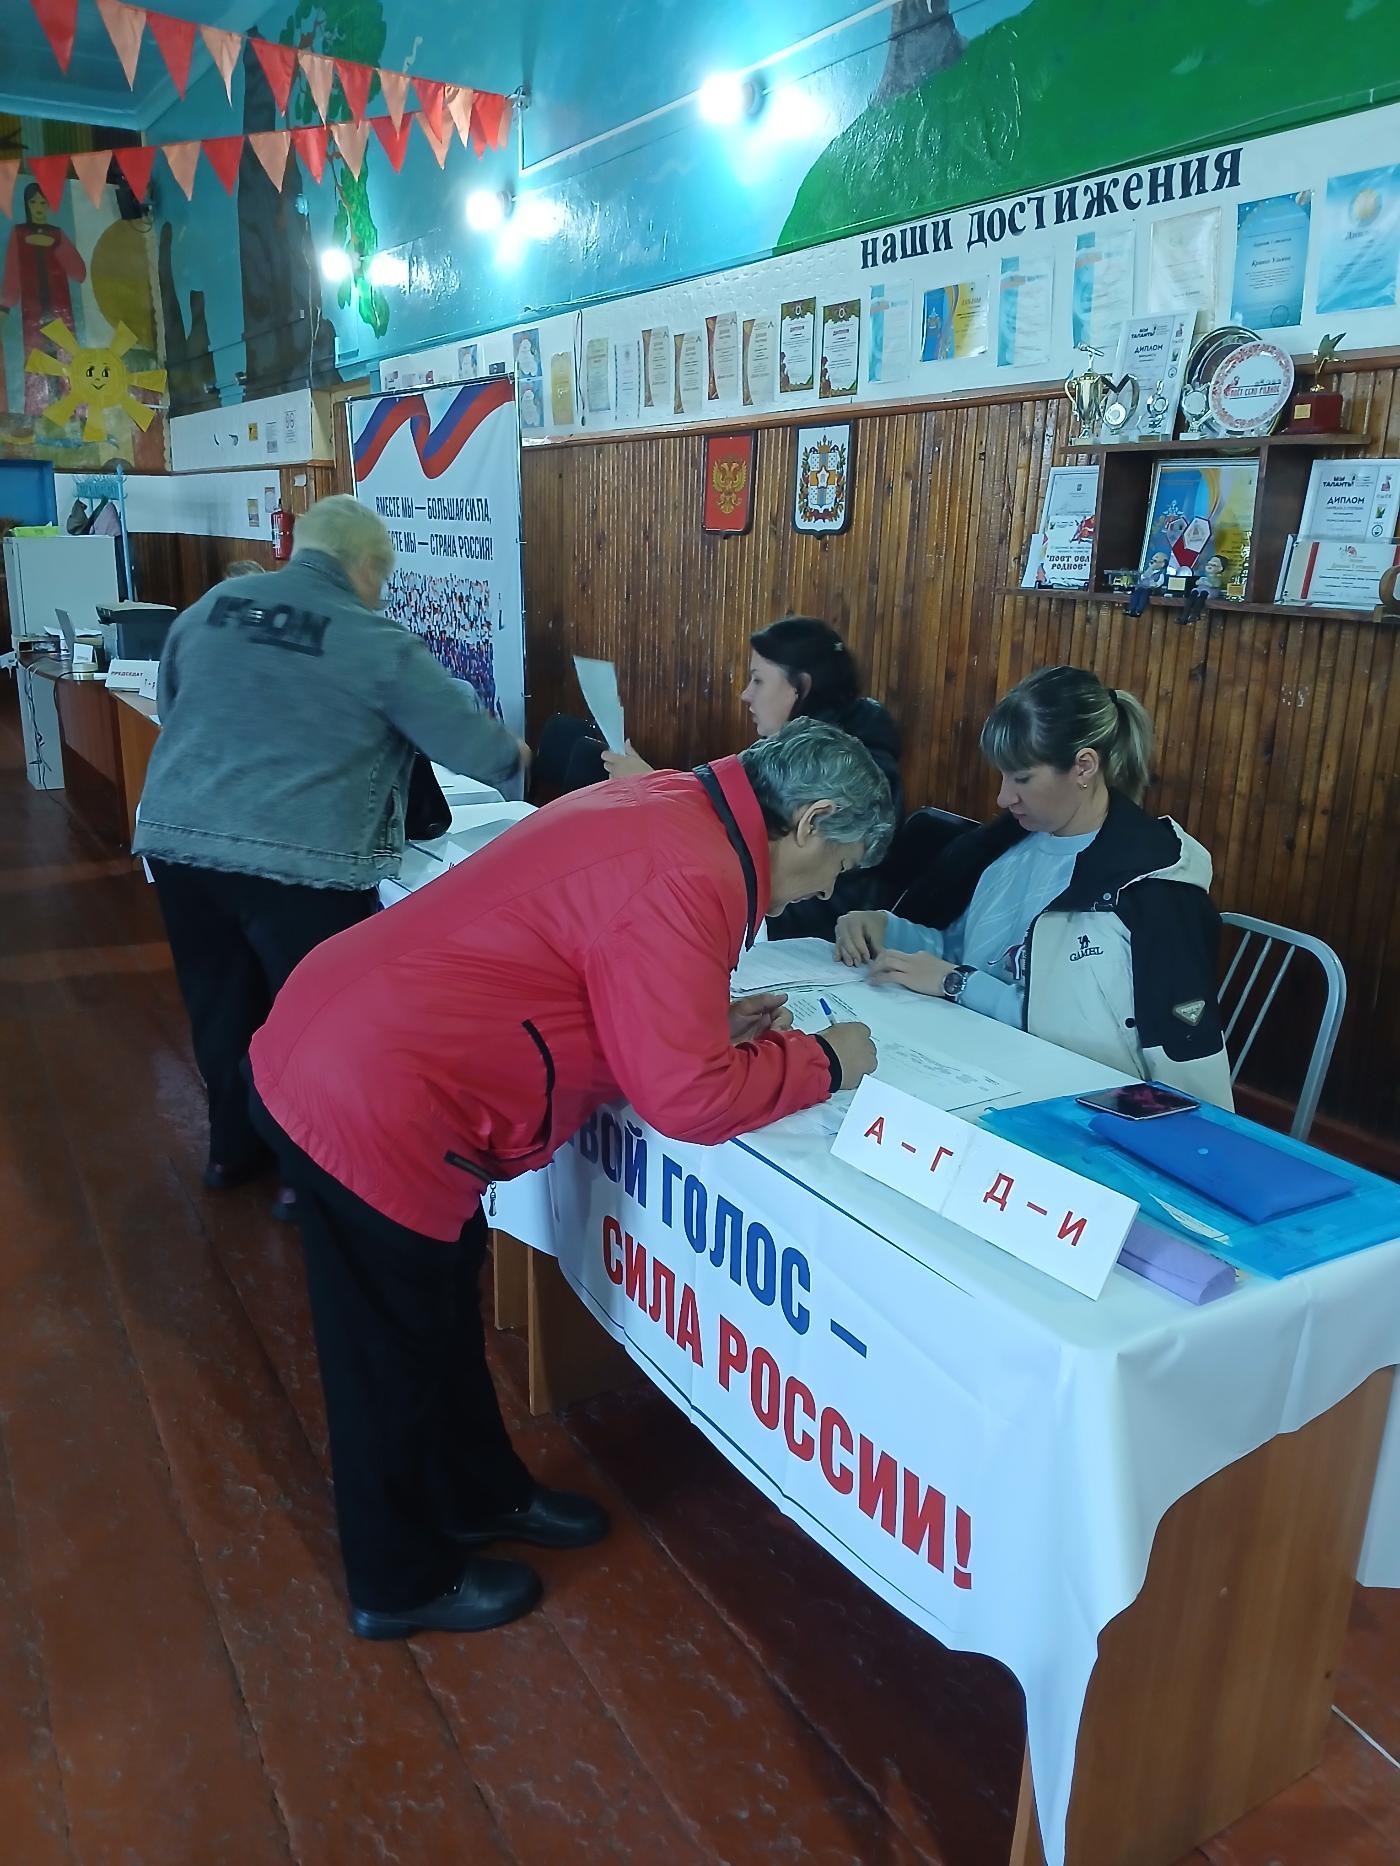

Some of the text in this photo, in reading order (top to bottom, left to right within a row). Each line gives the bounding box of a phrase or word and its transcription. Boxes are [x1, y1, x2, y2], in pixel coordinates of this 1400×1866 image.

[860, 147, 1243, 269] наши достижения
[1134, 344, 1163, 354] ДИПЛОМ
[375, 496, 401, 518] ВМЕСТЕ
[401, 497, 414, 519] МЫ
[427, 497, 464, 521] БОЛЬШАЯ
[464, 497, 492, 525] СИЛА,
[1327, 496, 1366, 505] ДИПЛОМ
[403, 531, 417, 554] МЫ
[429, 533, 458, 558] СТРАНА
[457, 535, 493, 561] РОССИЯ!
[864, 1115, 885, 1145] А
[929, 1145, 954, 1173] Г
[569, 1111, 648, 1209] ВОЙ
[661, 1153, 811, 1336] ГОЛОС
[982, 1172, 1015, 1212] Д
[1056, 1210, 1088, 1247] И
[602, 1214, 973, 1590] СИЛА РОССИИ!
